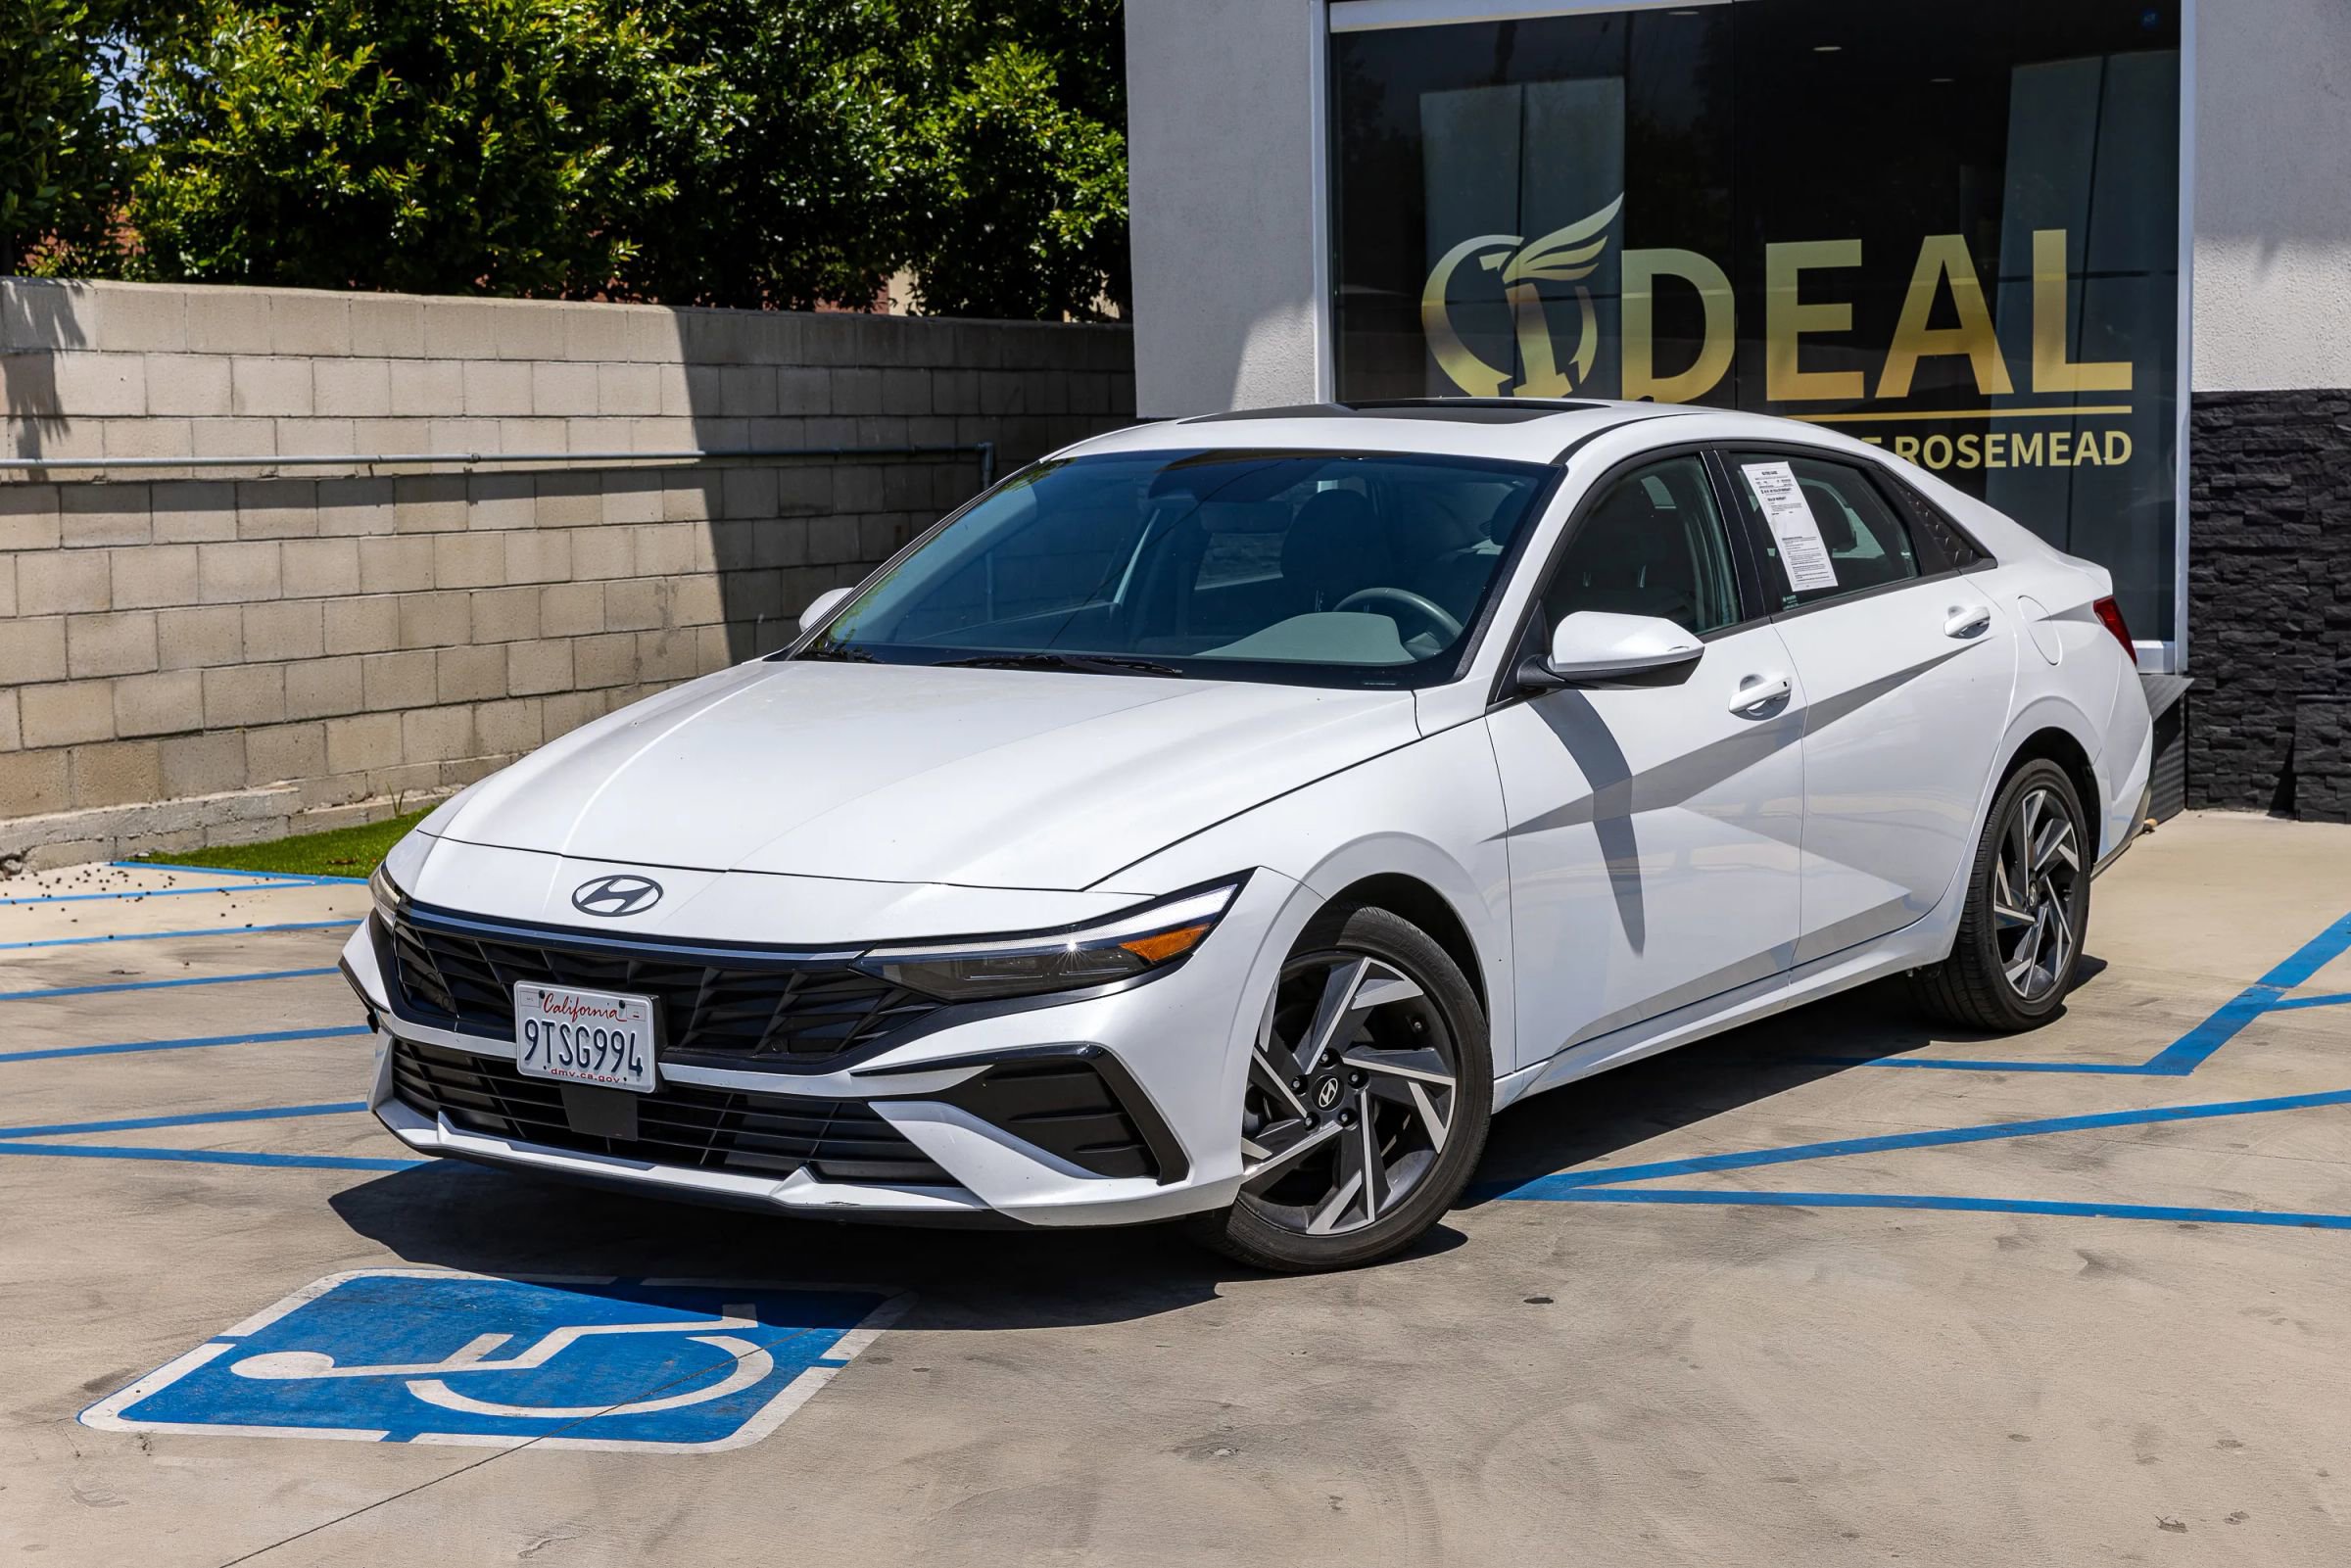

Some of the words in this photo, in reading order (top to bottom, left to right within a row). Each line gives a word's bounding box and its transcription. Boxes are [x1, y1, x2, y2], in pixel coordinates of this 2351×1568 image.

[1895, 431, 2133, 470] ROSEMEAD
[544, 993, 627, 1022] California
[525, 1020, 643, 1076] 9TSG994
[551, 1068, 620, 1083] dmv.ca.gov
